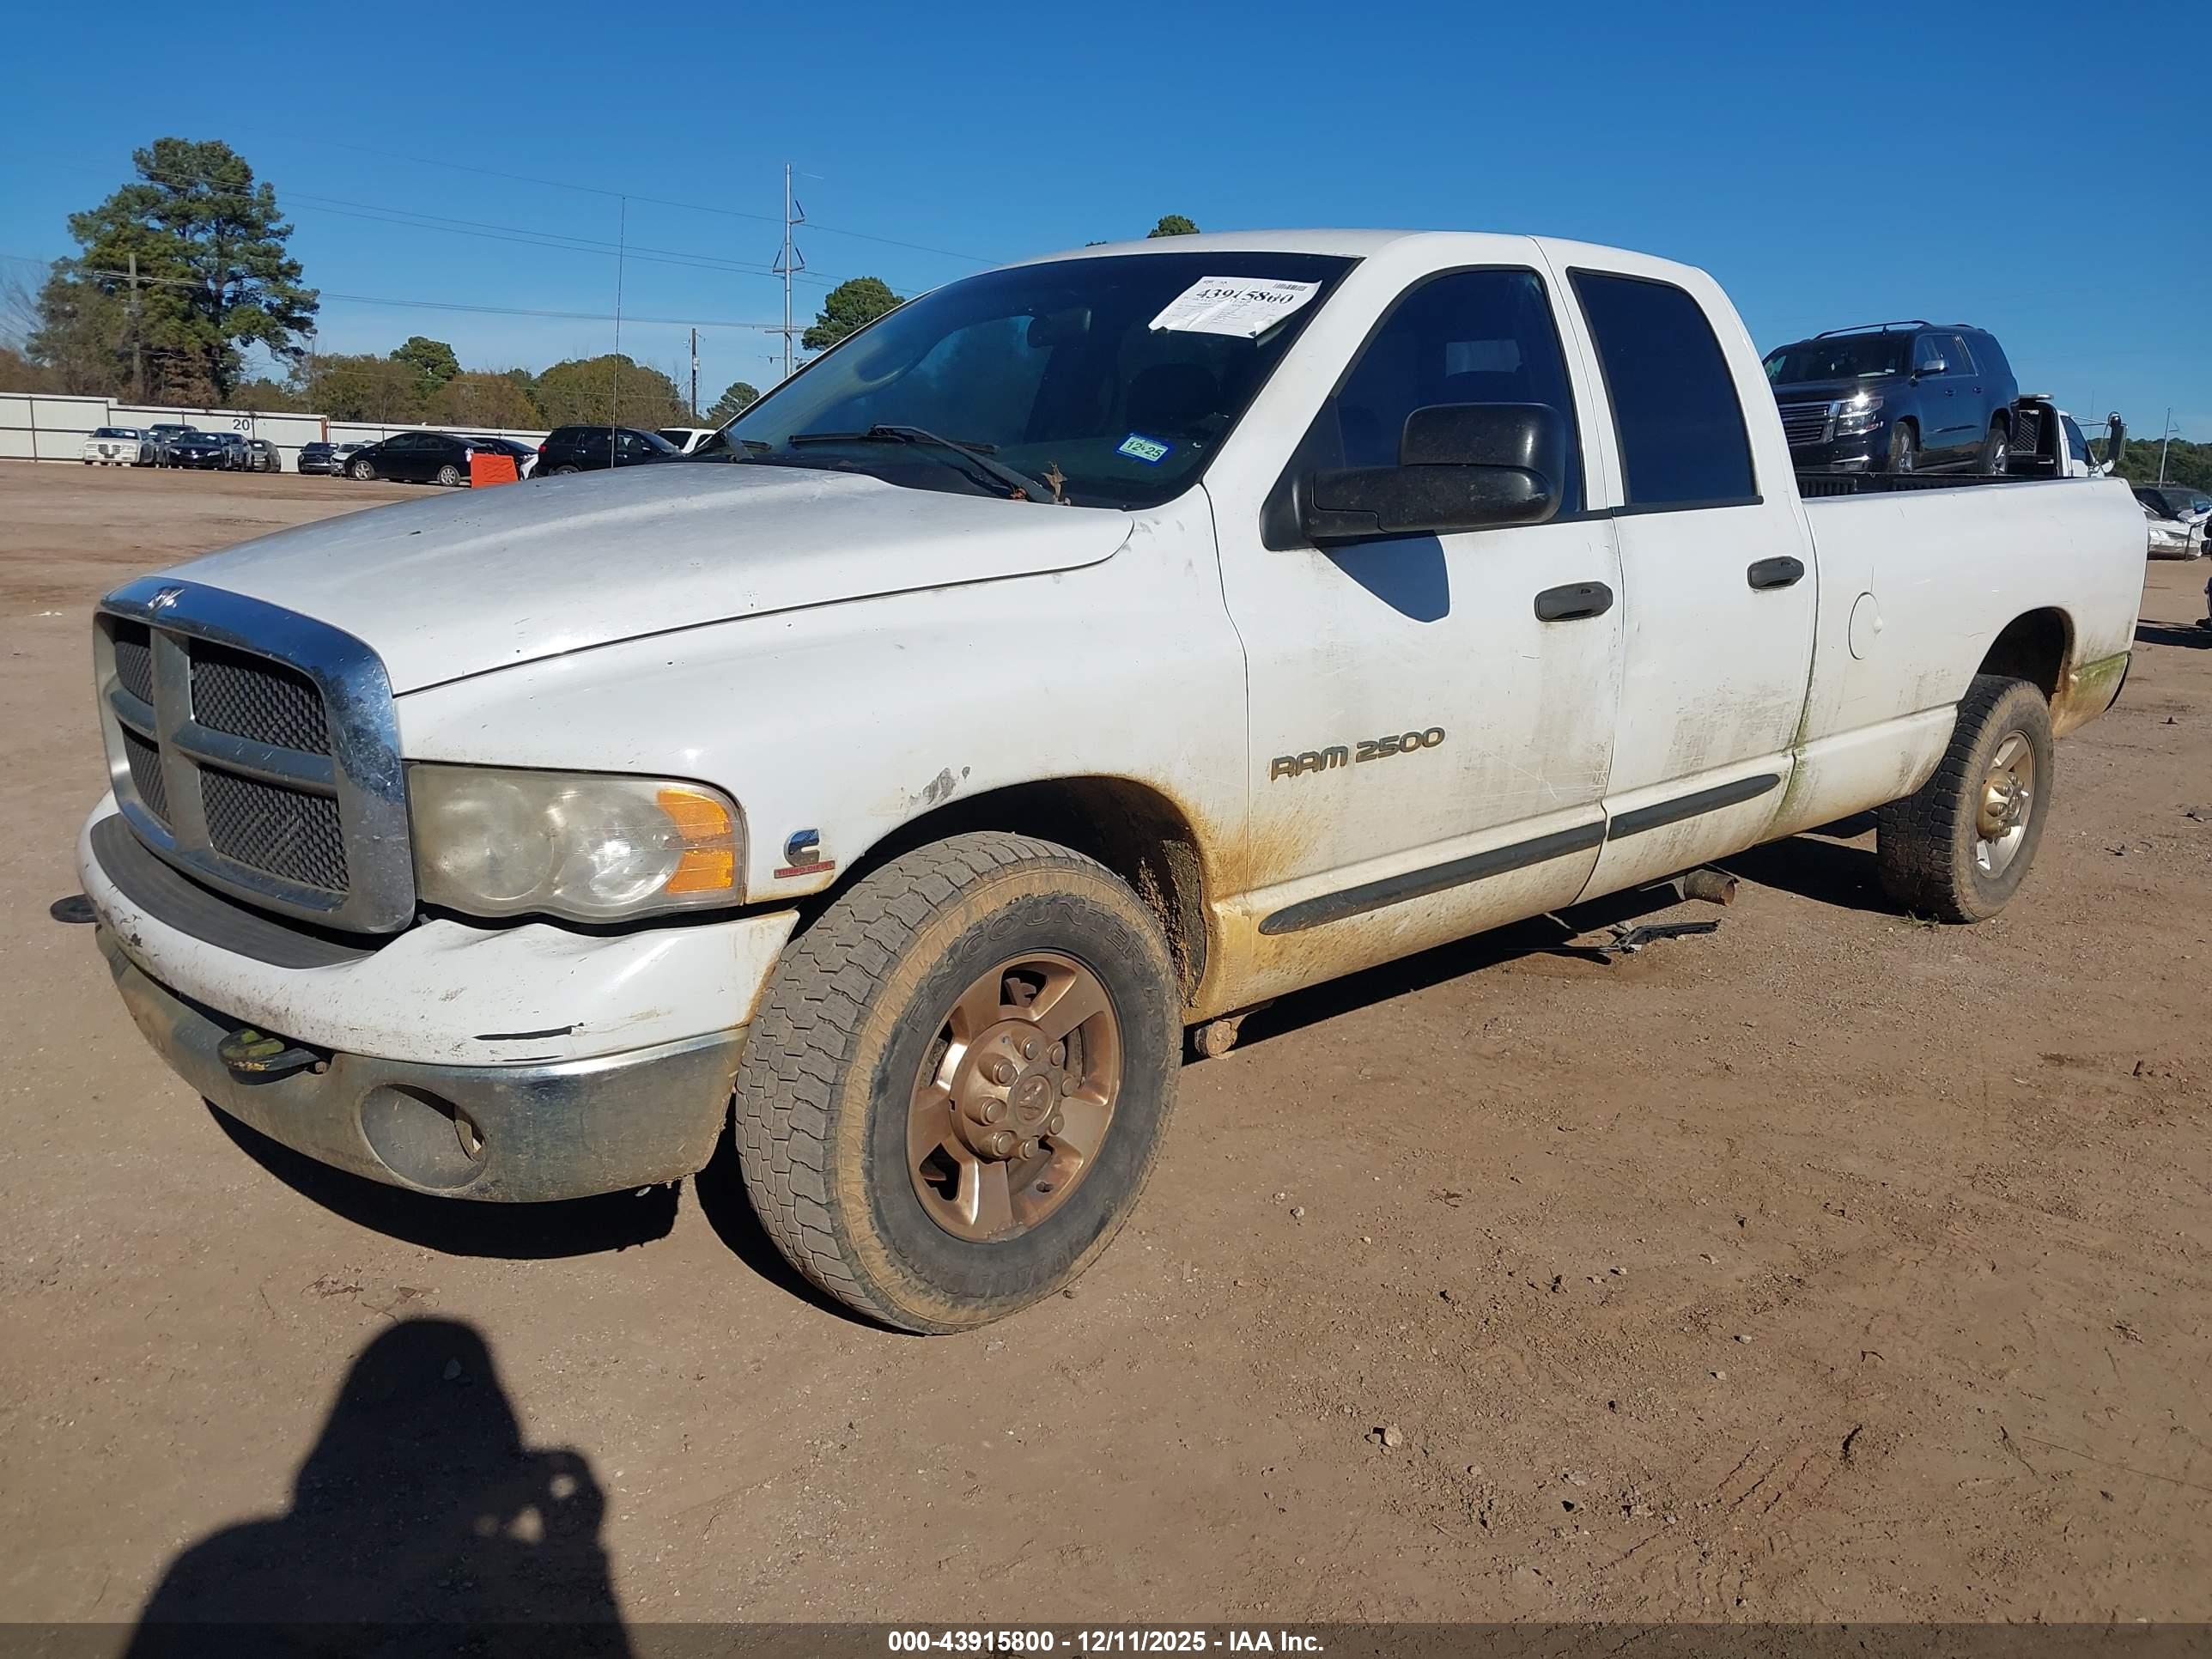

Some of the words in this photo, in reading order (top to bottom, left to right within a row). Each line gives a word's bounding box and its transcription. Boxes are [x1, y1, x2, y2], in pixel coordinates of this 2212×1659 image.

[233, 418, 251, 431] 20
[1270, 745, 1349, 781] RAM
[1355, 726, 1446, 763] 2500
